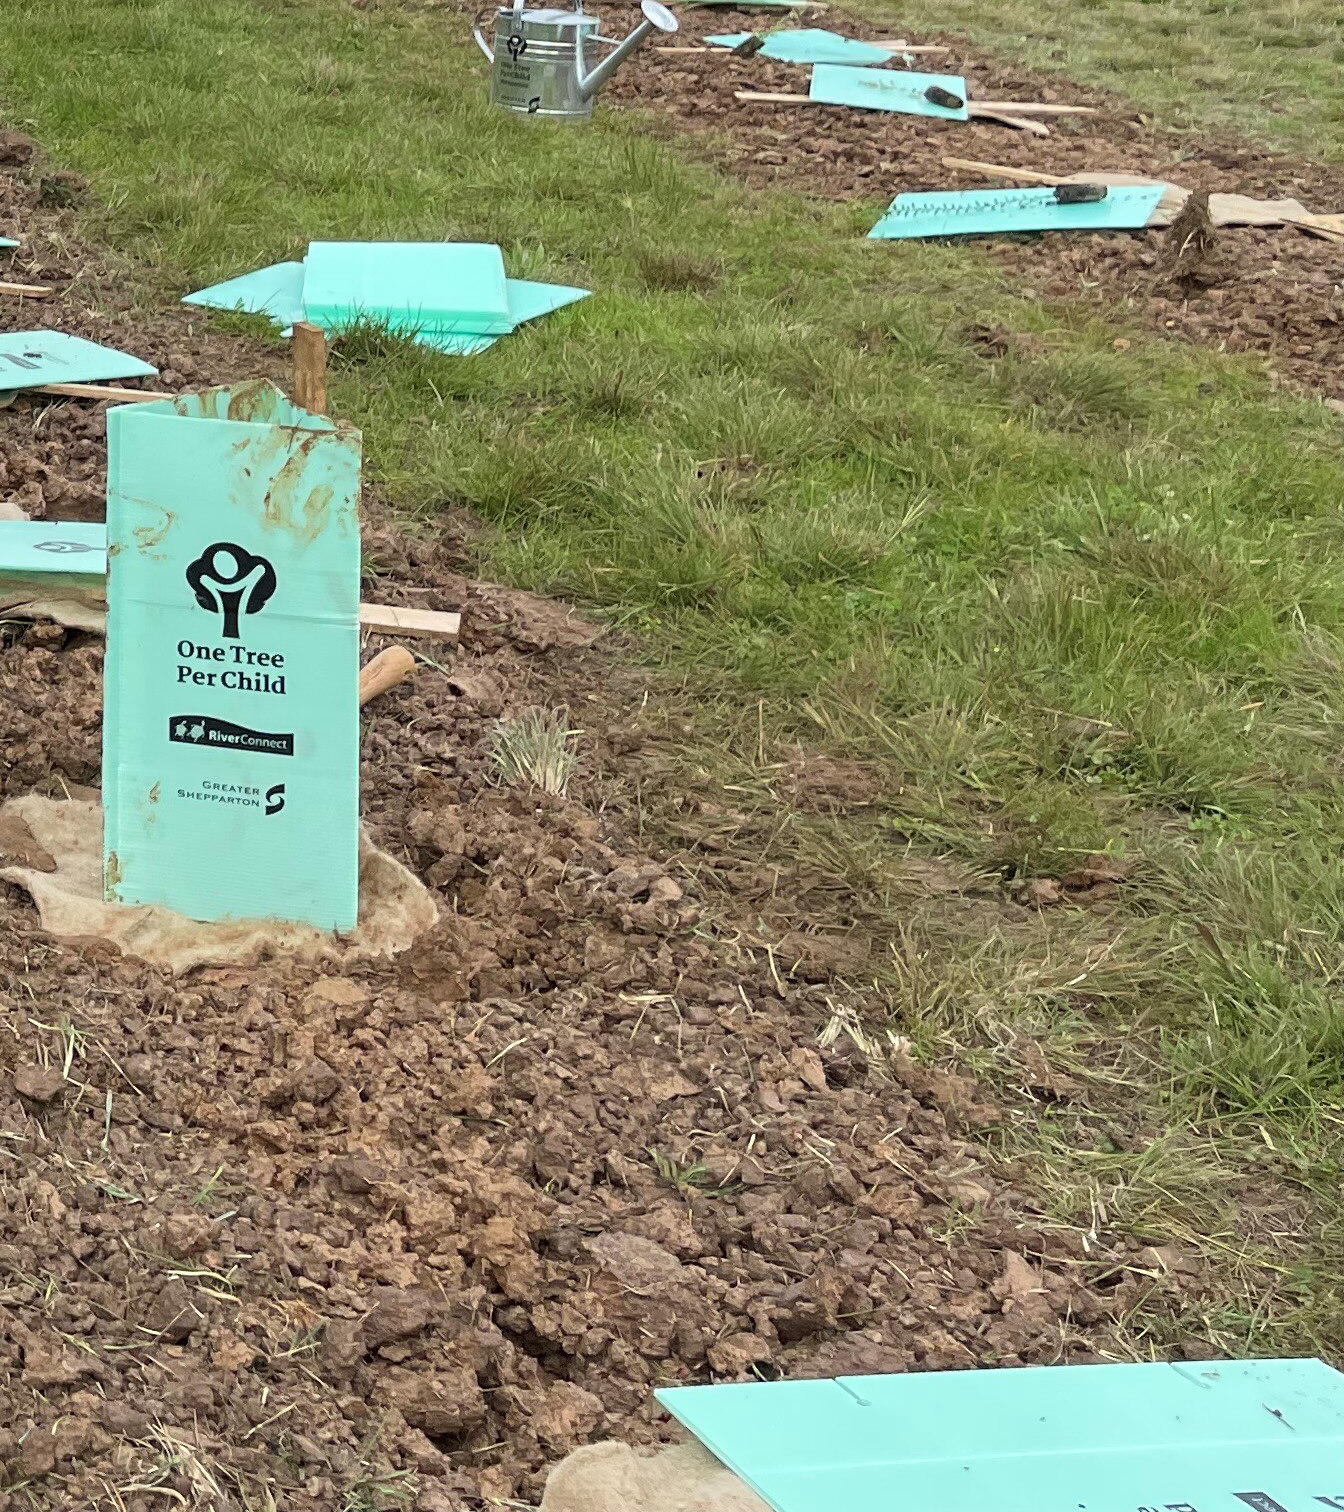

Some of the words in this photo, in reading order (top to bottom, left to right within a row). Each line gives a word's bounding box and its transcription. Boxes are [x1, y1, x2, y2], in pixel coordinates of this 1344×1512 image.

[177, 640, 226, 662] One
[229, 645, 285, 669] Tree
[176, 664, 218, 687] Per
[220, 670, 287, 695] Child
[209, 730, 288, 749] RiverConnect
[177, 788, 260, 808] SHEPPARTON
[202, 780, 260, 796] GREATER
